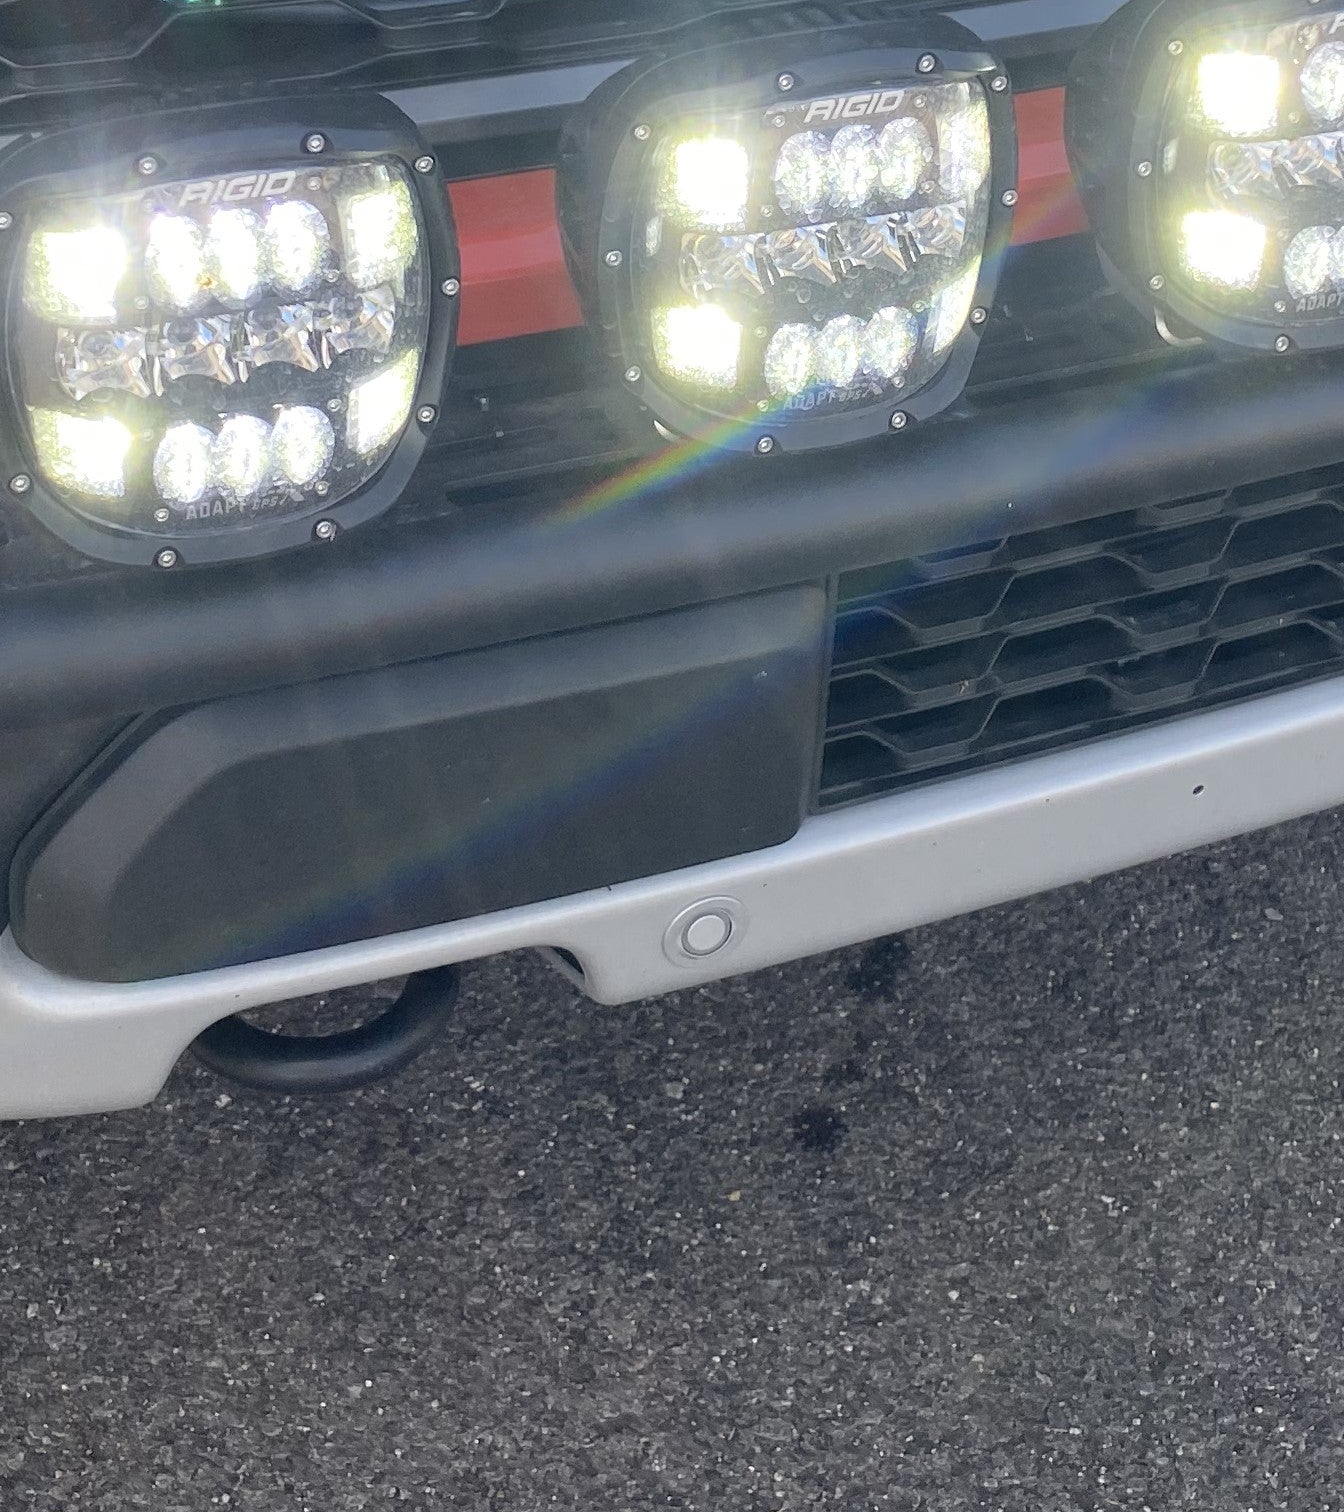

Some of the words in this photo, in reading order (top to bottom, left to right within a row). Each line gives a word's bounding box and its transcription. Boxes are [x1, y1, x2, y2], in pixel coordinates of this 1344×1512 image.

[803, 89, 905, 124] RIGID
[178, 170, 297, 210] RIGID
[185, 495, 248, 521] ADAPT
